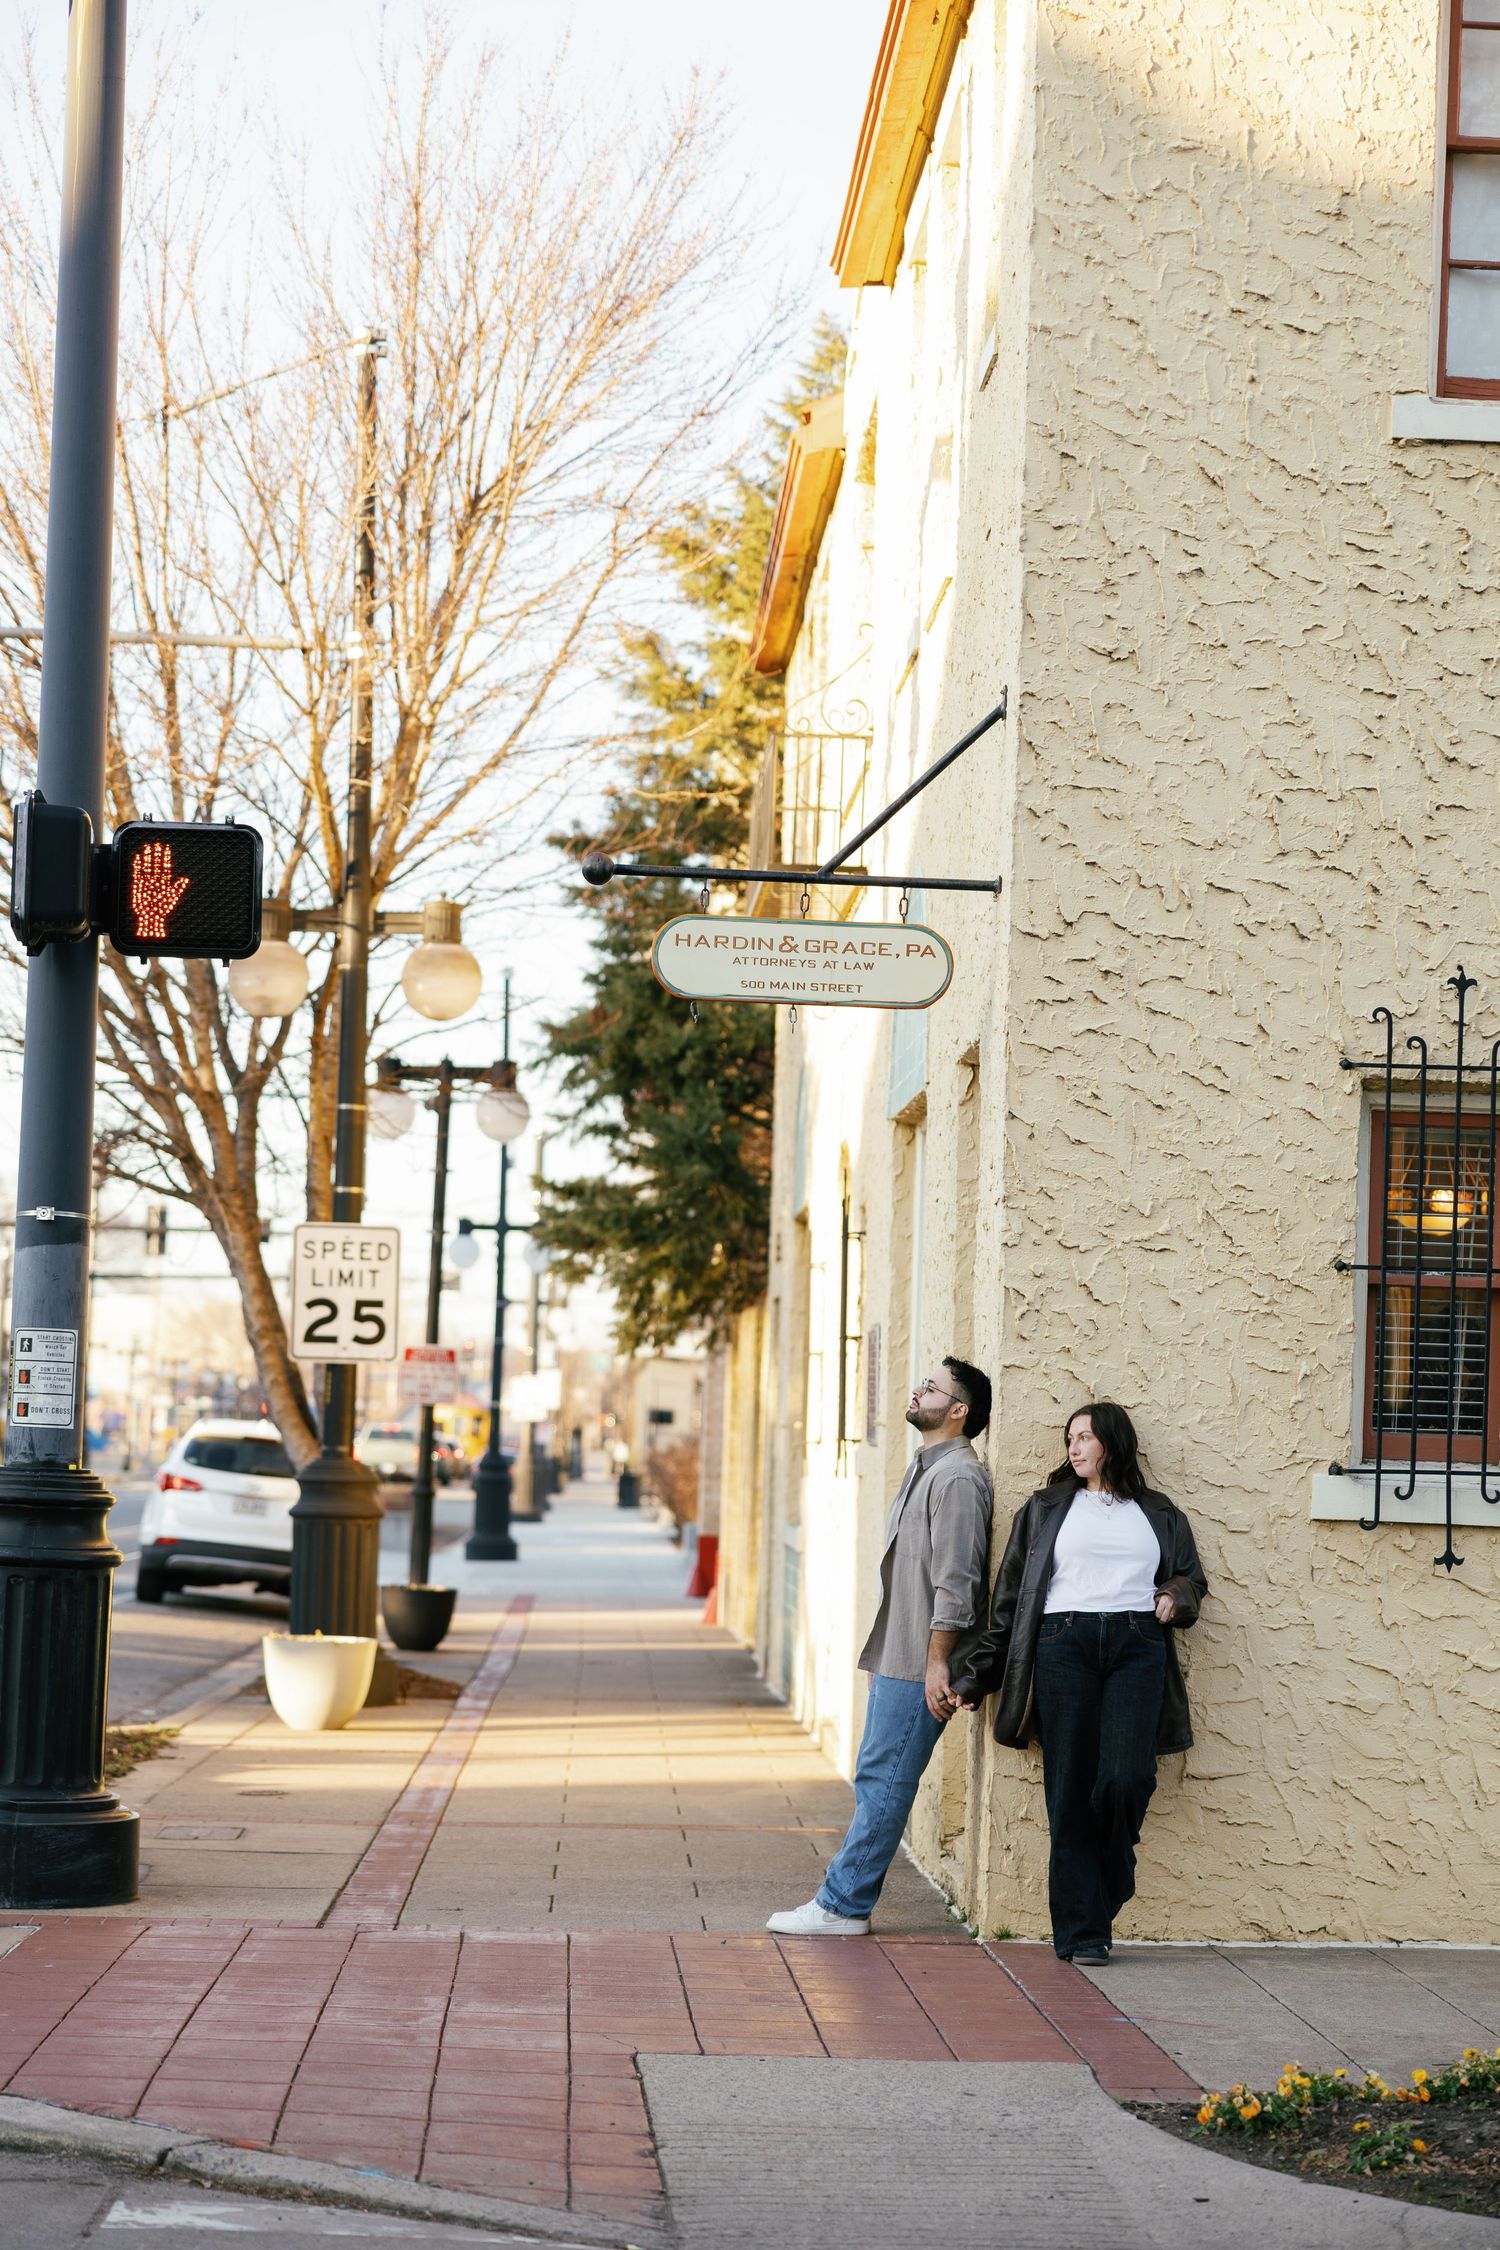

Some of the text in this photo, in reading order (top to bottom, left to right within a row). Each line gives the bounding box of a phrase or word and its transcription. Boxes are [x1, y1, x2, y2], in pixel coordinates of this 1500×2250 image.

[675, 933, 937, 959] HARDIN & GRACE, PA
[732, 956, 875, 972] ATTORNEYS AT LAW
[740, 979, 864, 994] 500 MAIN STREET
[303, 1240, 392, 1262] SPEED
[312, 1268, 380, 1288] LIMIT
[303, 1297, 386, 1345] 25
[51, 1407, 71, 1415] CROSS
